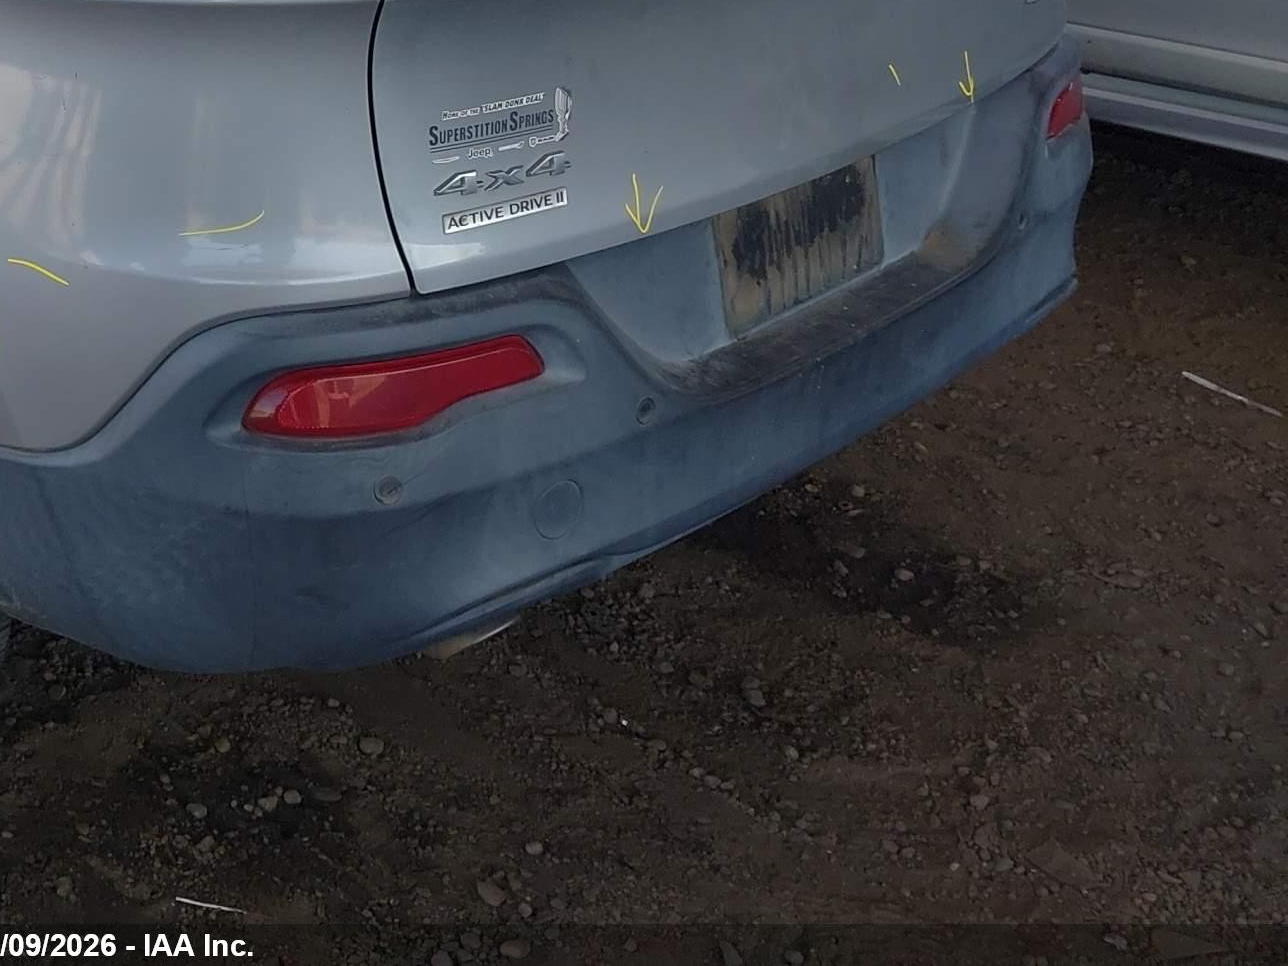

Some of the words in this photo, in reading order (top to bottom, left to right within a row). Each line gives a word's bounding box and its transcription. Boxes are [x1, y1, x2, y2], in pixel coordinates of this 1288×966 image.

[429, 119, 507, 146] SUPERSTITION
[510, 109, 553, 131] SPRINGS
[468, 147, 492, 159] Jeep
[447, 206, 505, 229] ACTIVE
[509, 194, 553, 216] DRIVE
